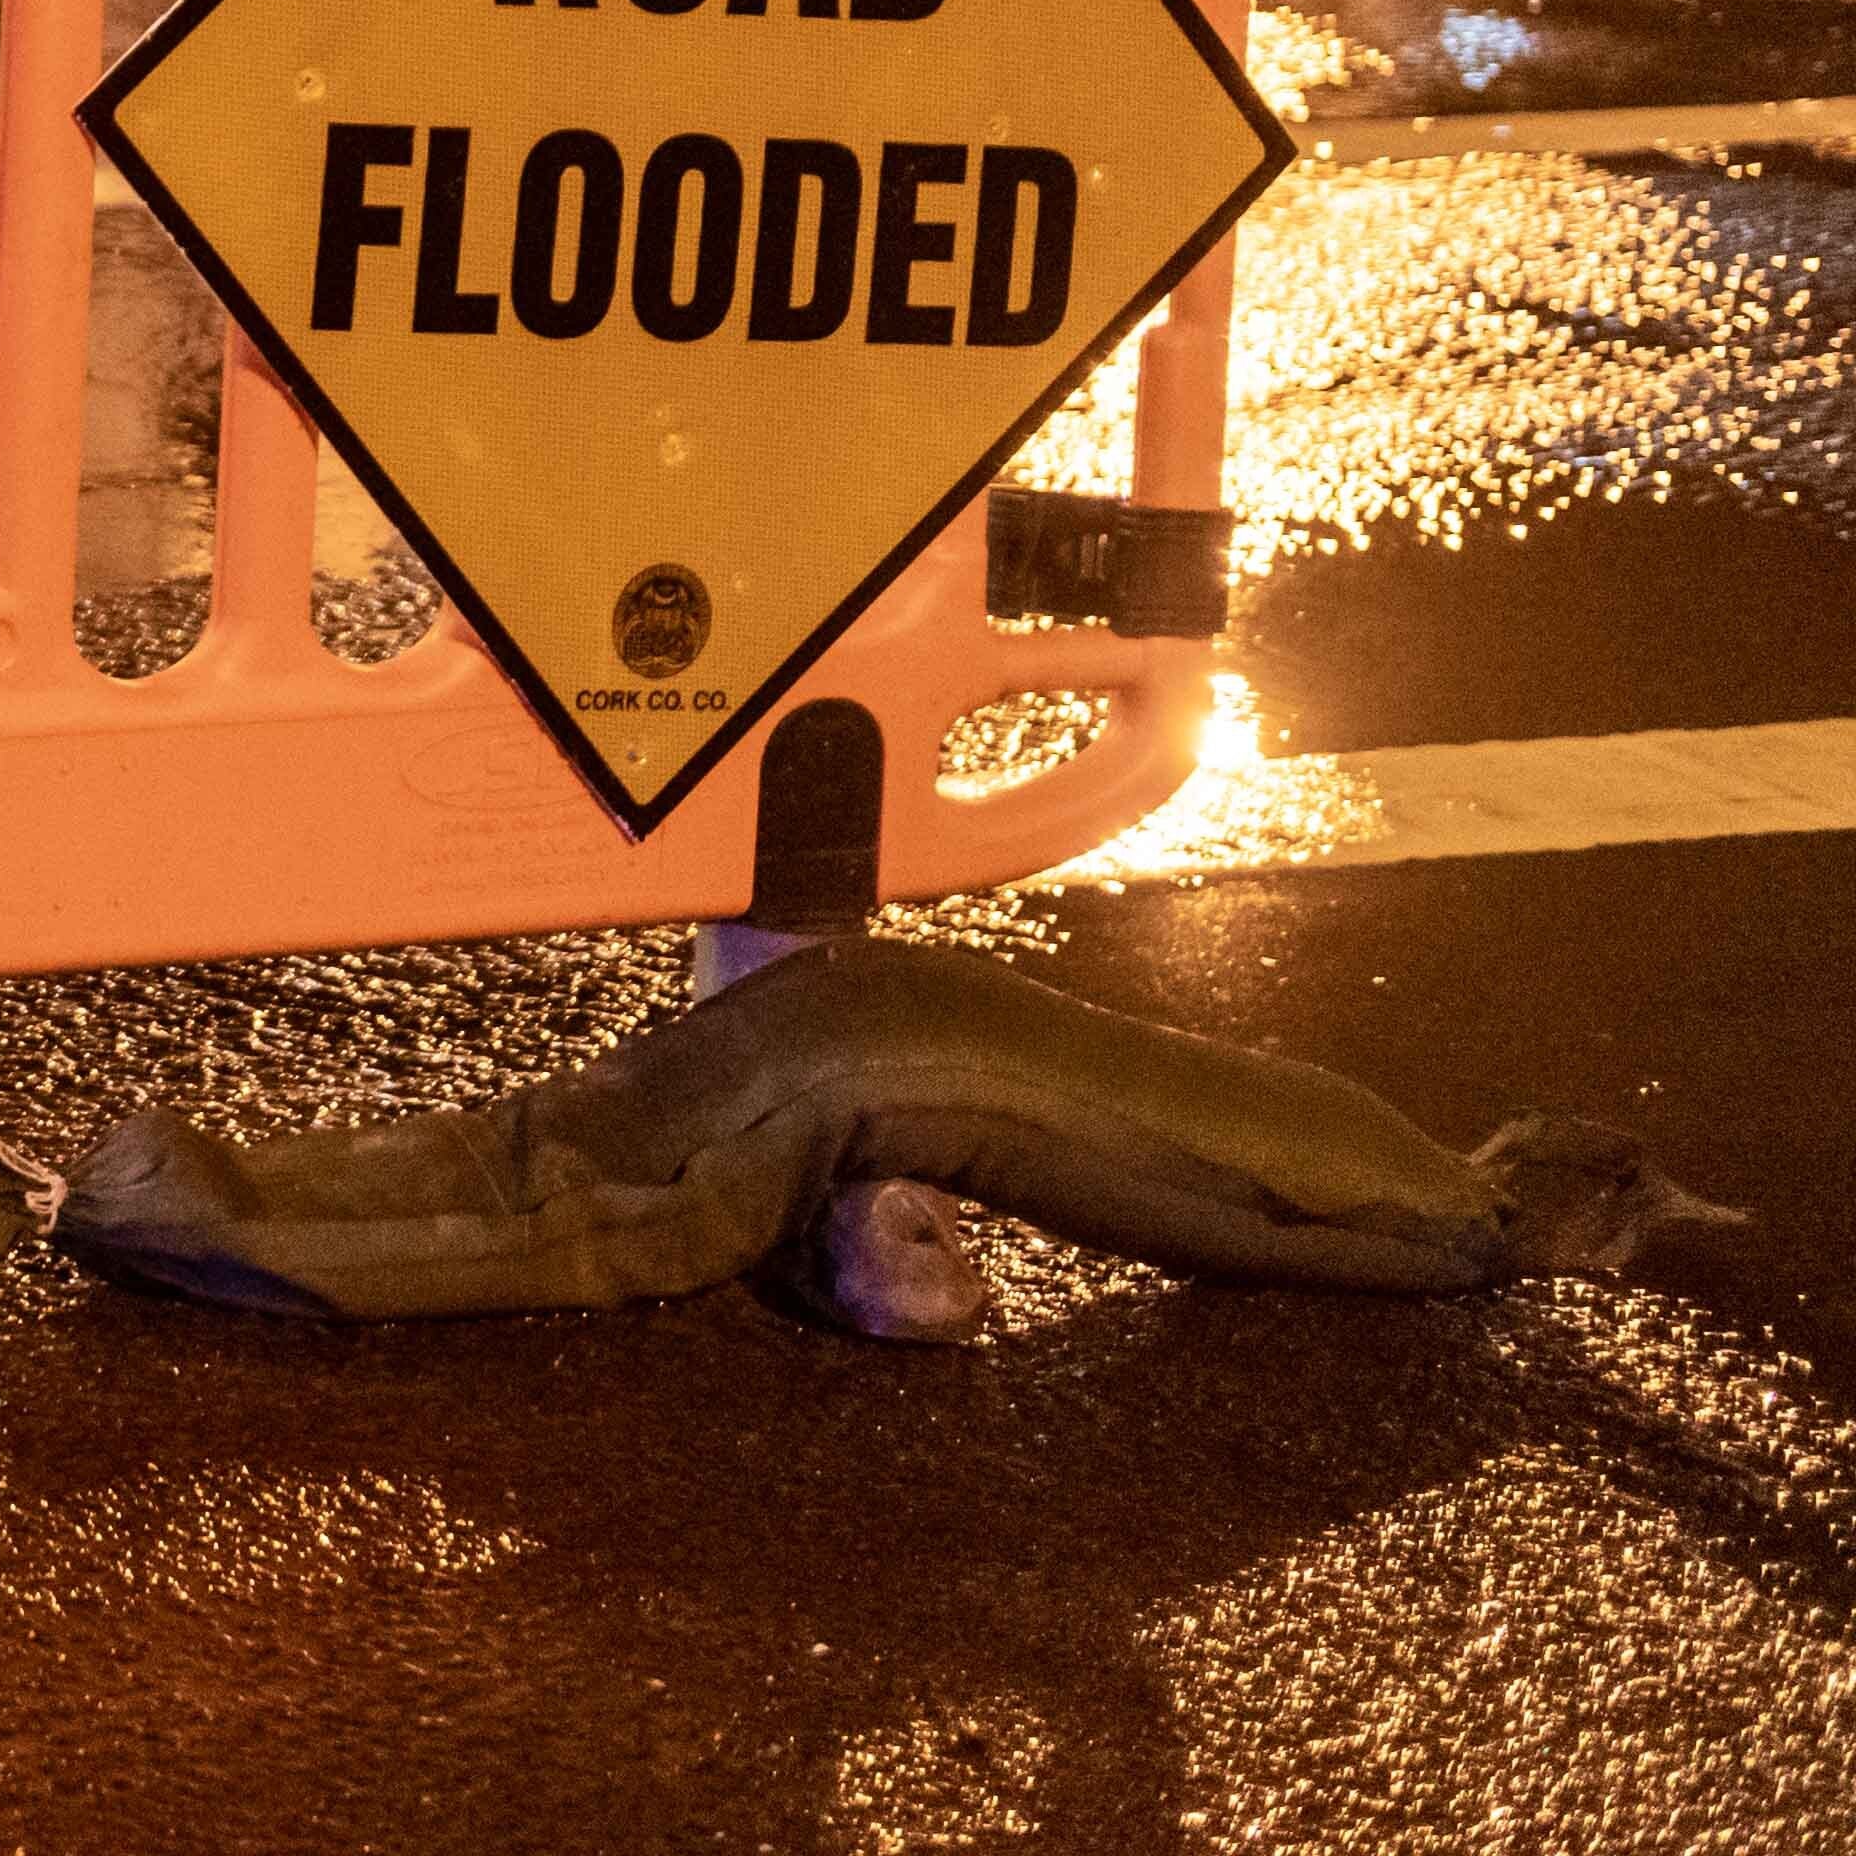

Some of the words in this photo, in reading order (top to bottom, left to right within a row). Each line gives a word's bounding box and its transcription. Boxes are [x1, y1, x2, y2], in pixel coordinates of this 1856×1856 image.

[312, 125, 1076, 345] FLOODED
[574, 689, 641, 712] CORK
[647, 690, 685, 712] CO.
[693, 690, 732, 712] CO.
